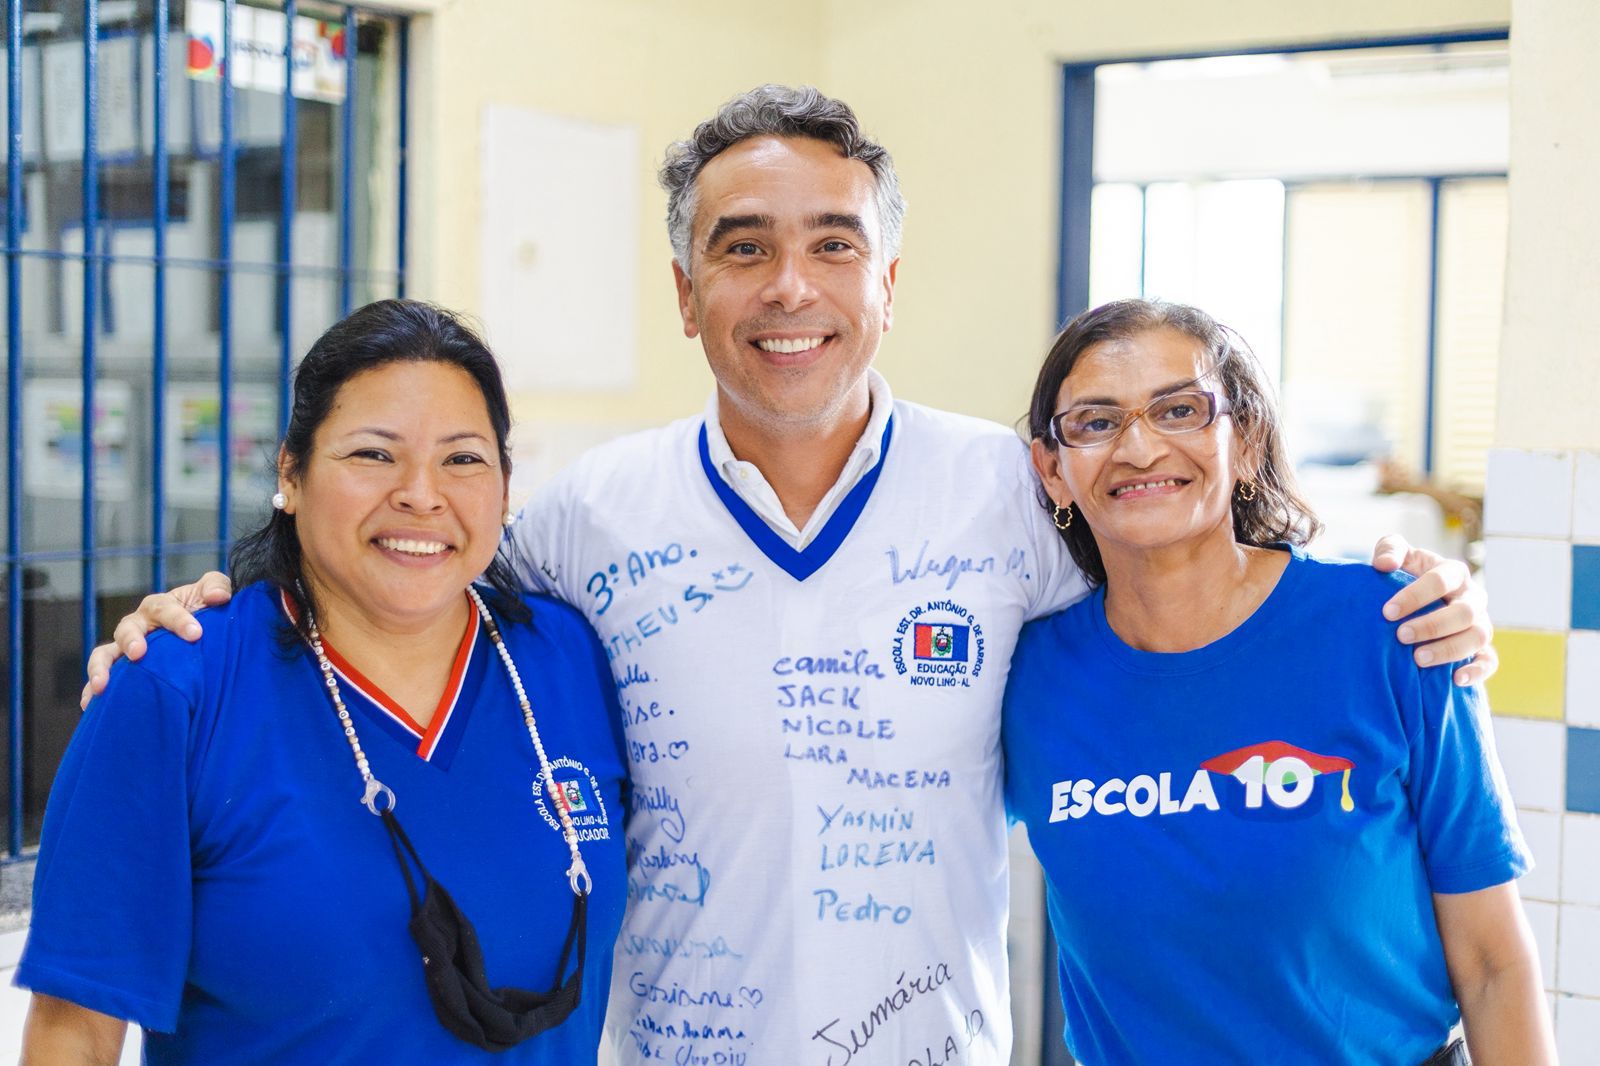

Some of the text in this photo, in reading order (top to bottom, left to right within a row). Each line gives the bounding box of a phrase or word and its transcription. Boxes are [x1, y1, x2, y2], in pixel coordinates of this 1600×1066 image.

[909, 606, 927, 620] DR.
[927, 599, 967, 618] ANTÔNIO
[896, 617, 913, 635] EST.
[972, 624, 983, 638] DE
[892, 637, 908, 675] ESCOLA
[972, 638, 984, 677] BARROS
[917, 662, 967, 677] EDUCAÇÃO
[910, 676, 935, 686] NOVO
[936, 677, 956, 687] LINO
[961, 678, 971, 687] AL
[777, 684, 861, 710] JACK
[846, 767, 951, 790] MACENA
[1049, 755, 1315, 823] ESCOLA 10
[534, 798, 561, 831] ESCOLA
[548, 755, 583, 772] ANTÔNIO
[562, 827, 611, 843] EUCADOR
[820, 839, 936, 872] LORENA
